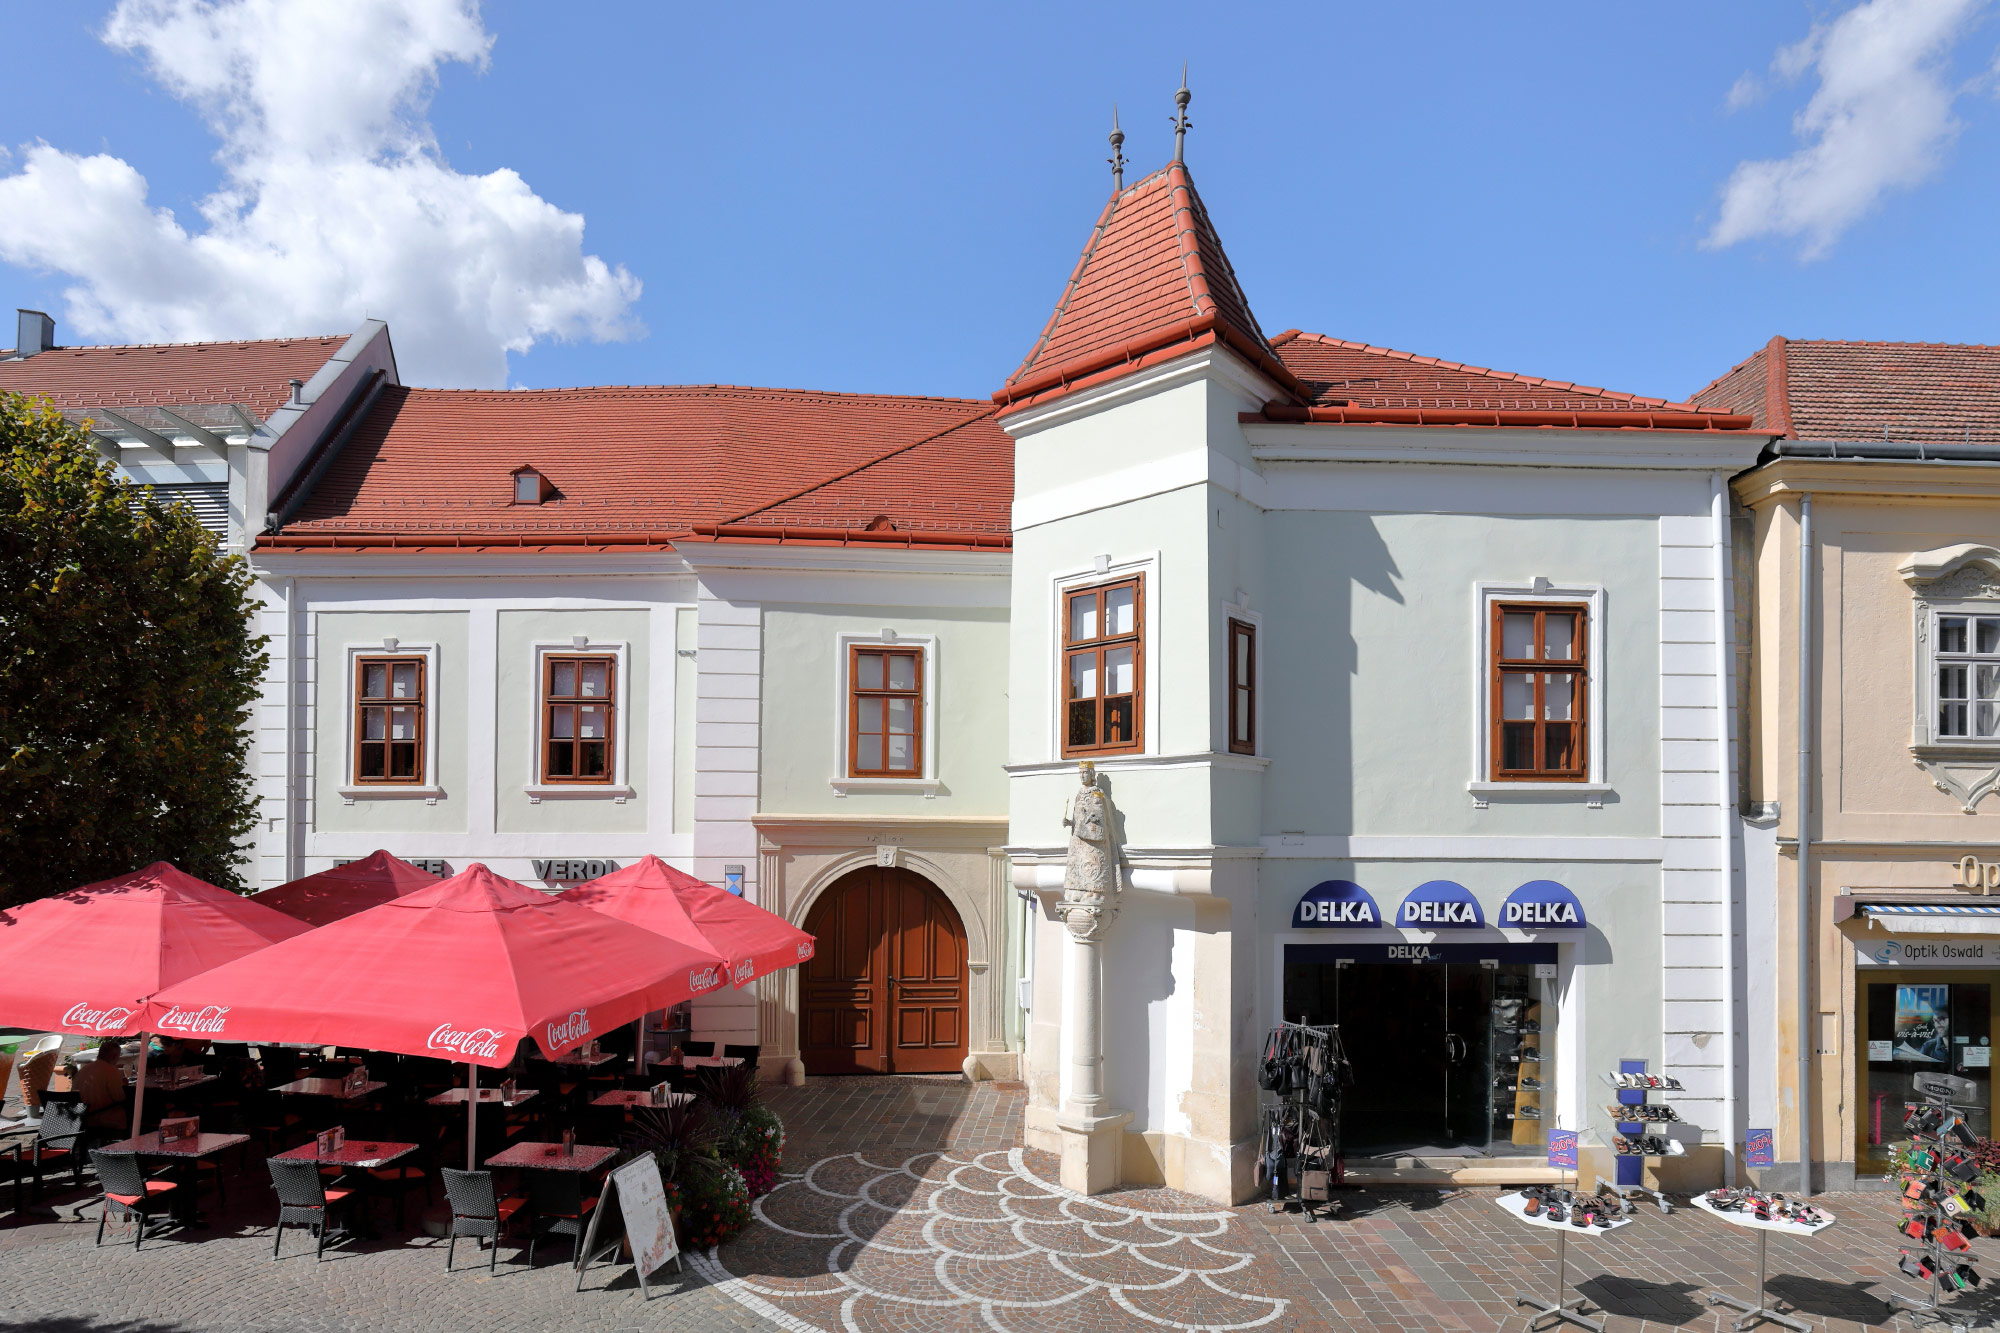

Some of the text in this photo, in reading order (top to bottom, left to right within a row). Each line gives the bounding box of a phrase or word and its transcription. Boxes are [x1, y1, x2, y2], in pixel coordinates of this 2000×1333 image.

[532, 859, 613, 879] VERDI
[1960, 855, 2000, 895] Op
[1300, 901, 1373, 922] DELKA
[1404, 901, 1477, 923] DELKA
[1506, 902, 1578, 923] DELKA
[1388, 945, 1430, 959] DELKA
[1905, 944, 1938, 960] Optik
[1942, 944, 1983, 958] Oswald
[1899, 987, 1946, 1011] NEU
[62, 1002, 138, 1031] Coca-Col
[157, 1005, 232, 1033] Coca-Cola
[427, 1023, 506, 1058] Coca-Cola
[547, 1008, 589, 1051] Coca-Cola
